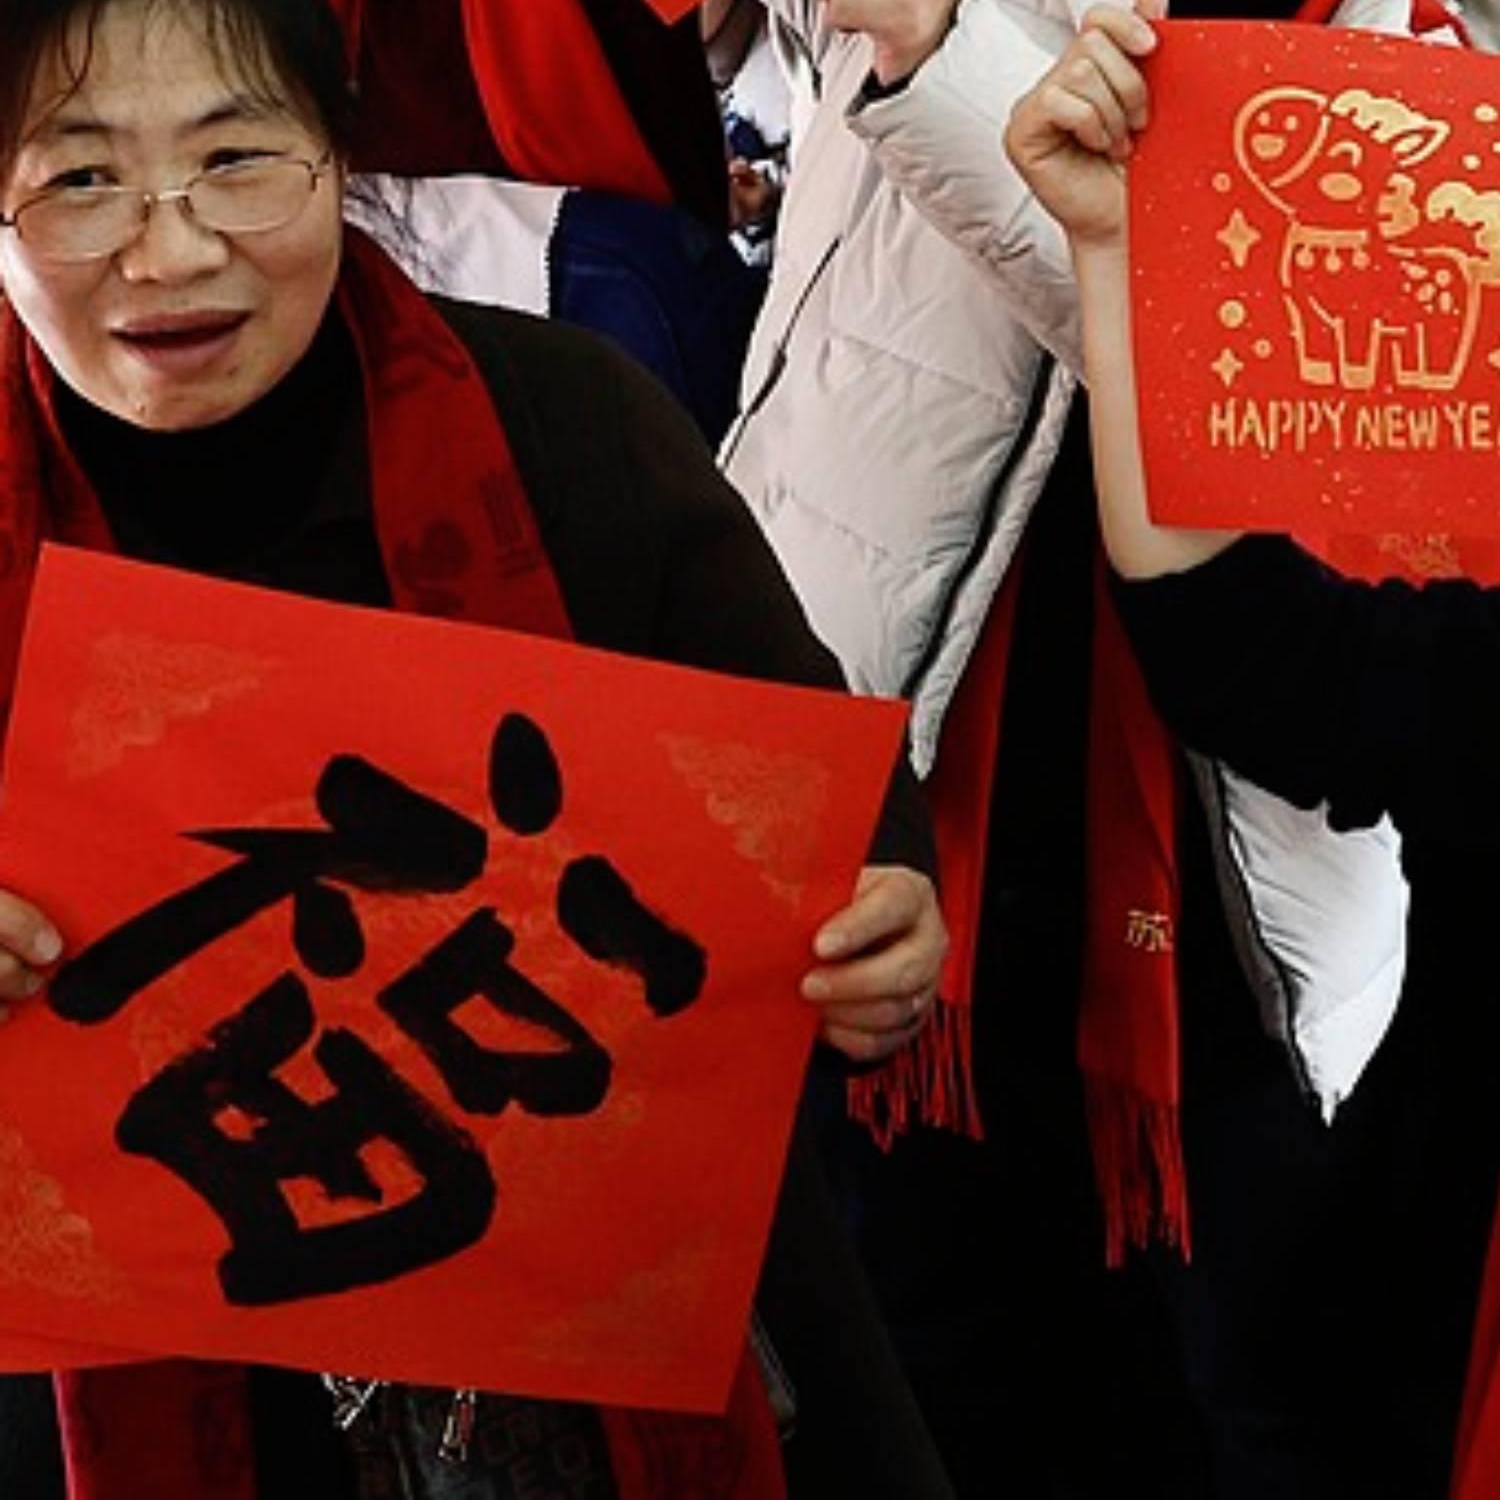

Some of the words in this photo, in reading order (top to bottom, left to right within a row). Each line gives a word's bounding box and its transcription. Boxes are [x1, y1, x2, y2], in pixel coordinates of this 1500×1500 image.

[1209, 398, 1343, 450] HAPPY
[1356, 404, 1438, 448] NEW
[46, 711, 708, 1309] 福
